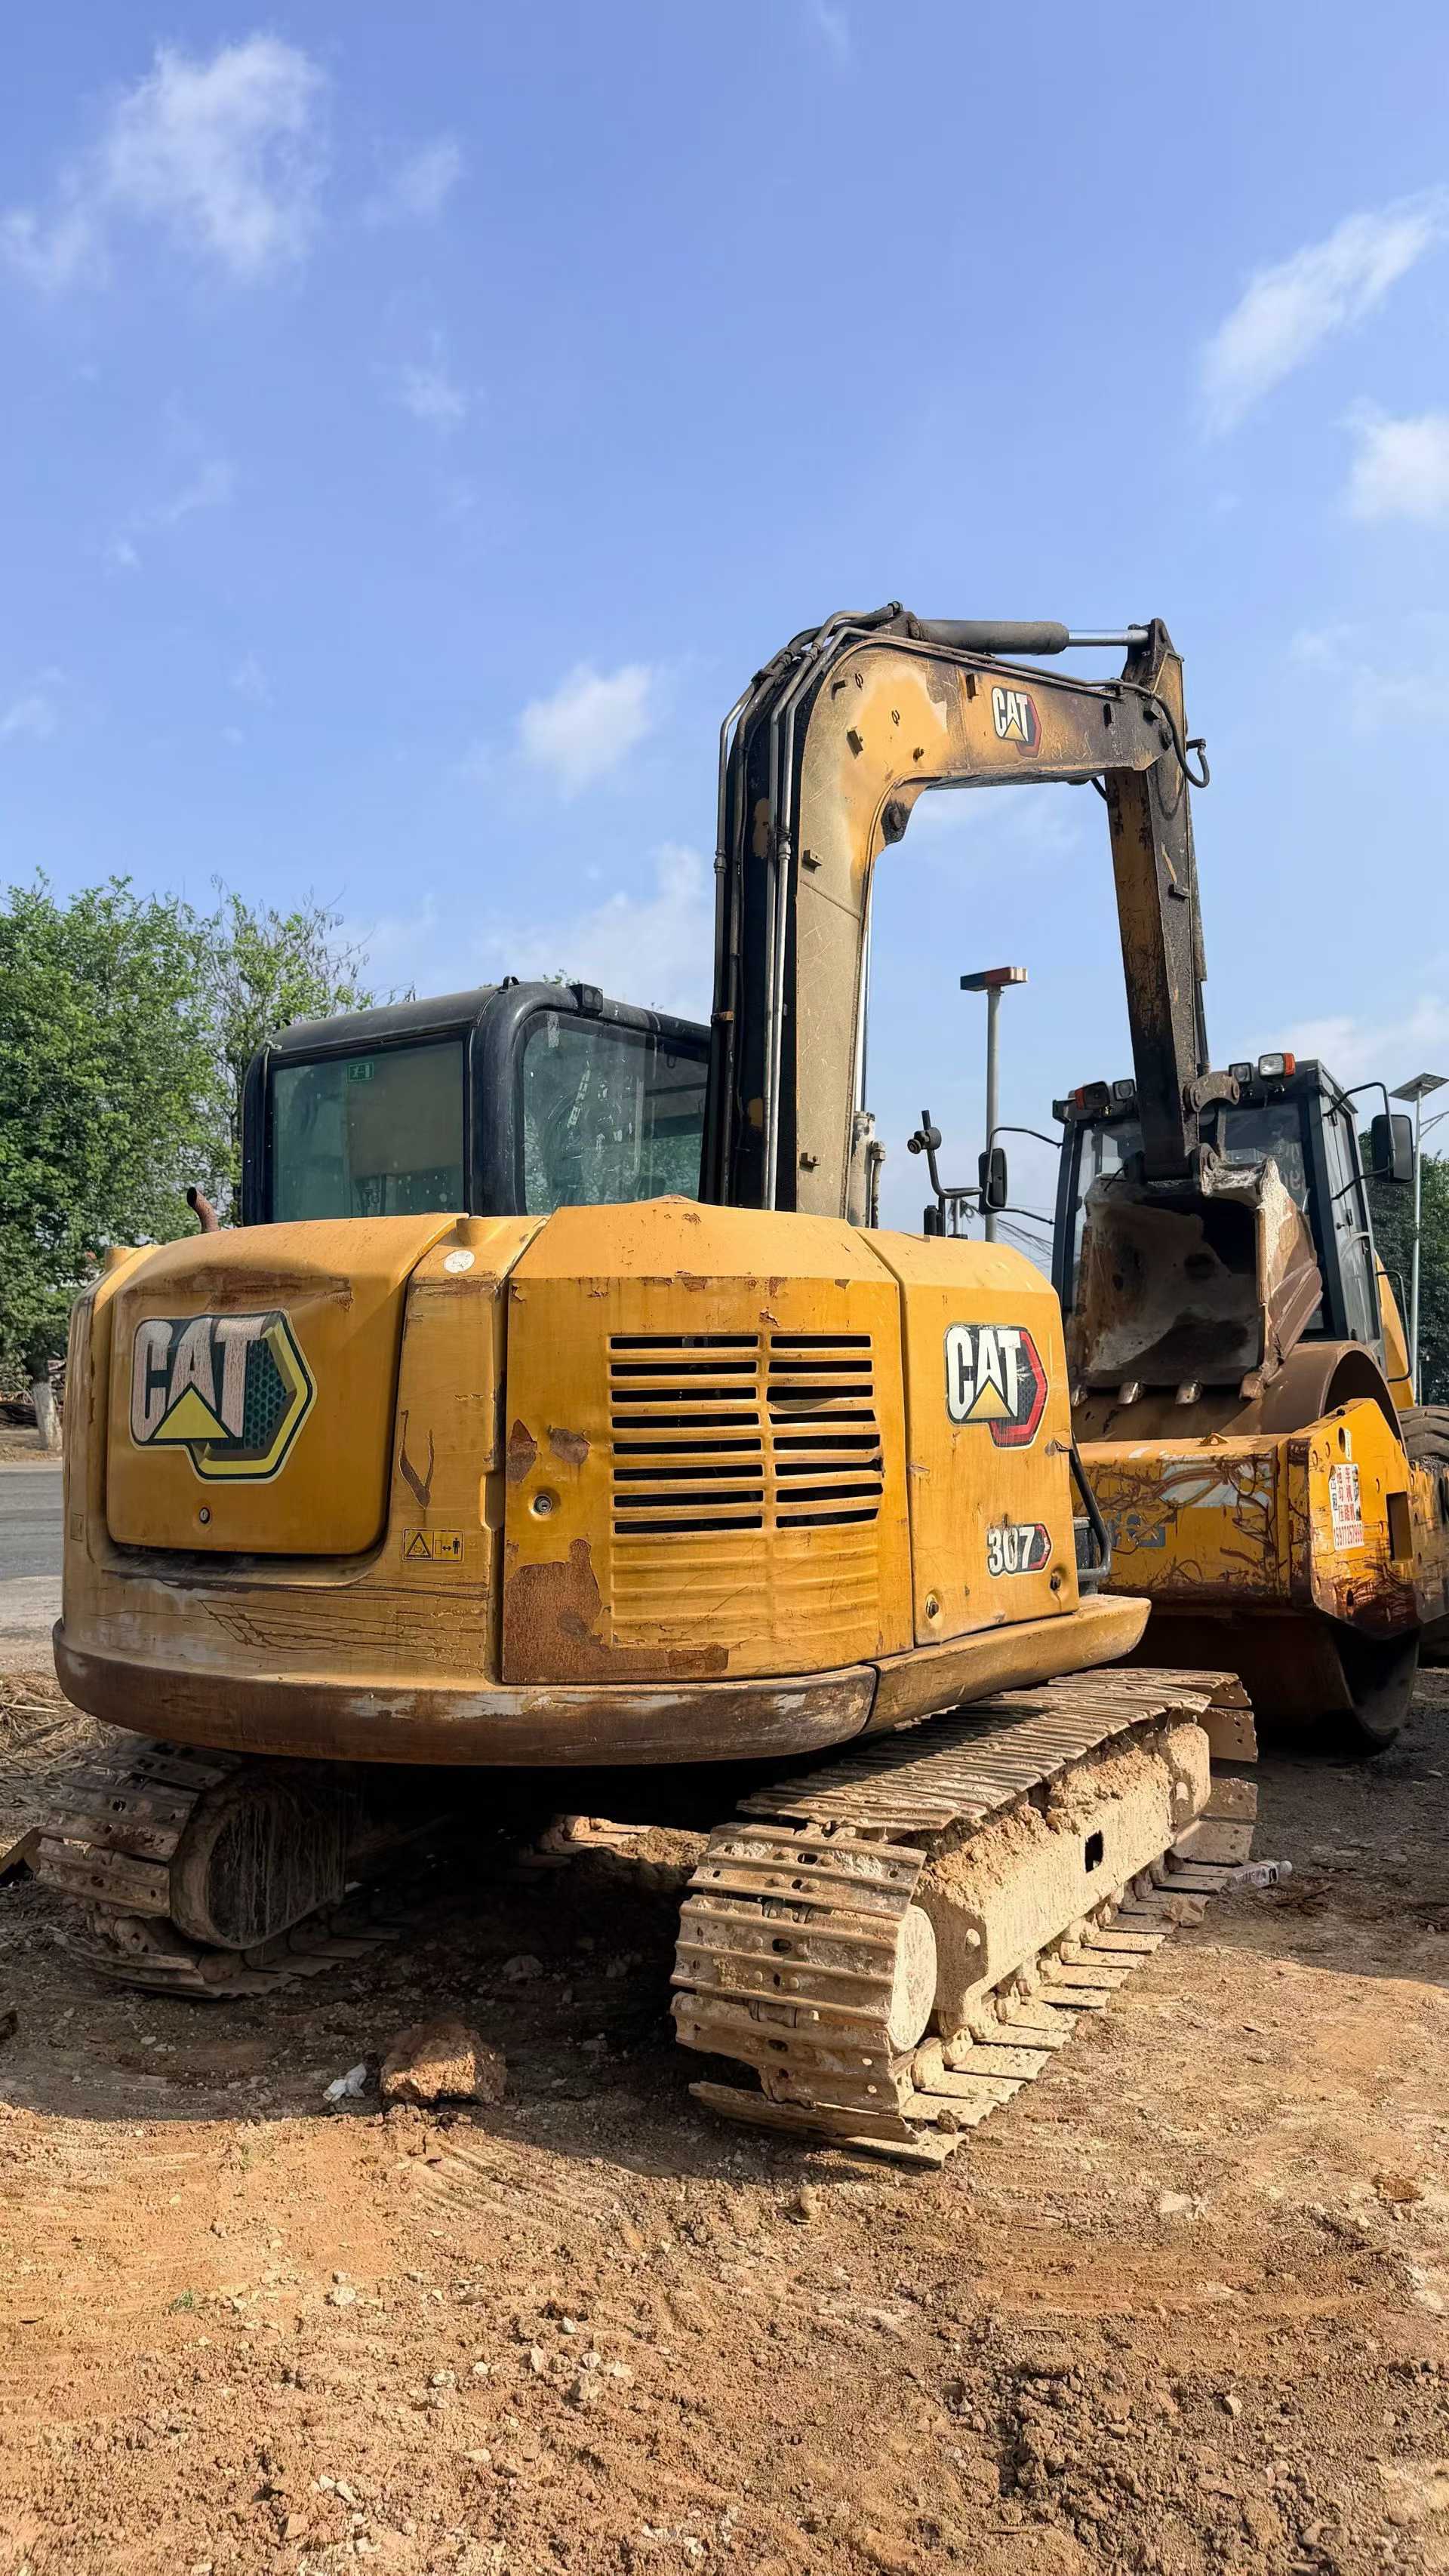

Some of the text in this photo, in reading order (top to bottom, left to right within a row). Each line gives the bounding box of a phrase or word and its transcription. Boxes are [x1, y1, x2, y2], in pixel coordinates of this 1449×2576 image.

[992, 687, 1028, 742] CAT
[132, 1317, 269, 1442] CAT
[947, 1326, 1021, 1419] CAT
[987, 1526, 1035, 1573] 307
